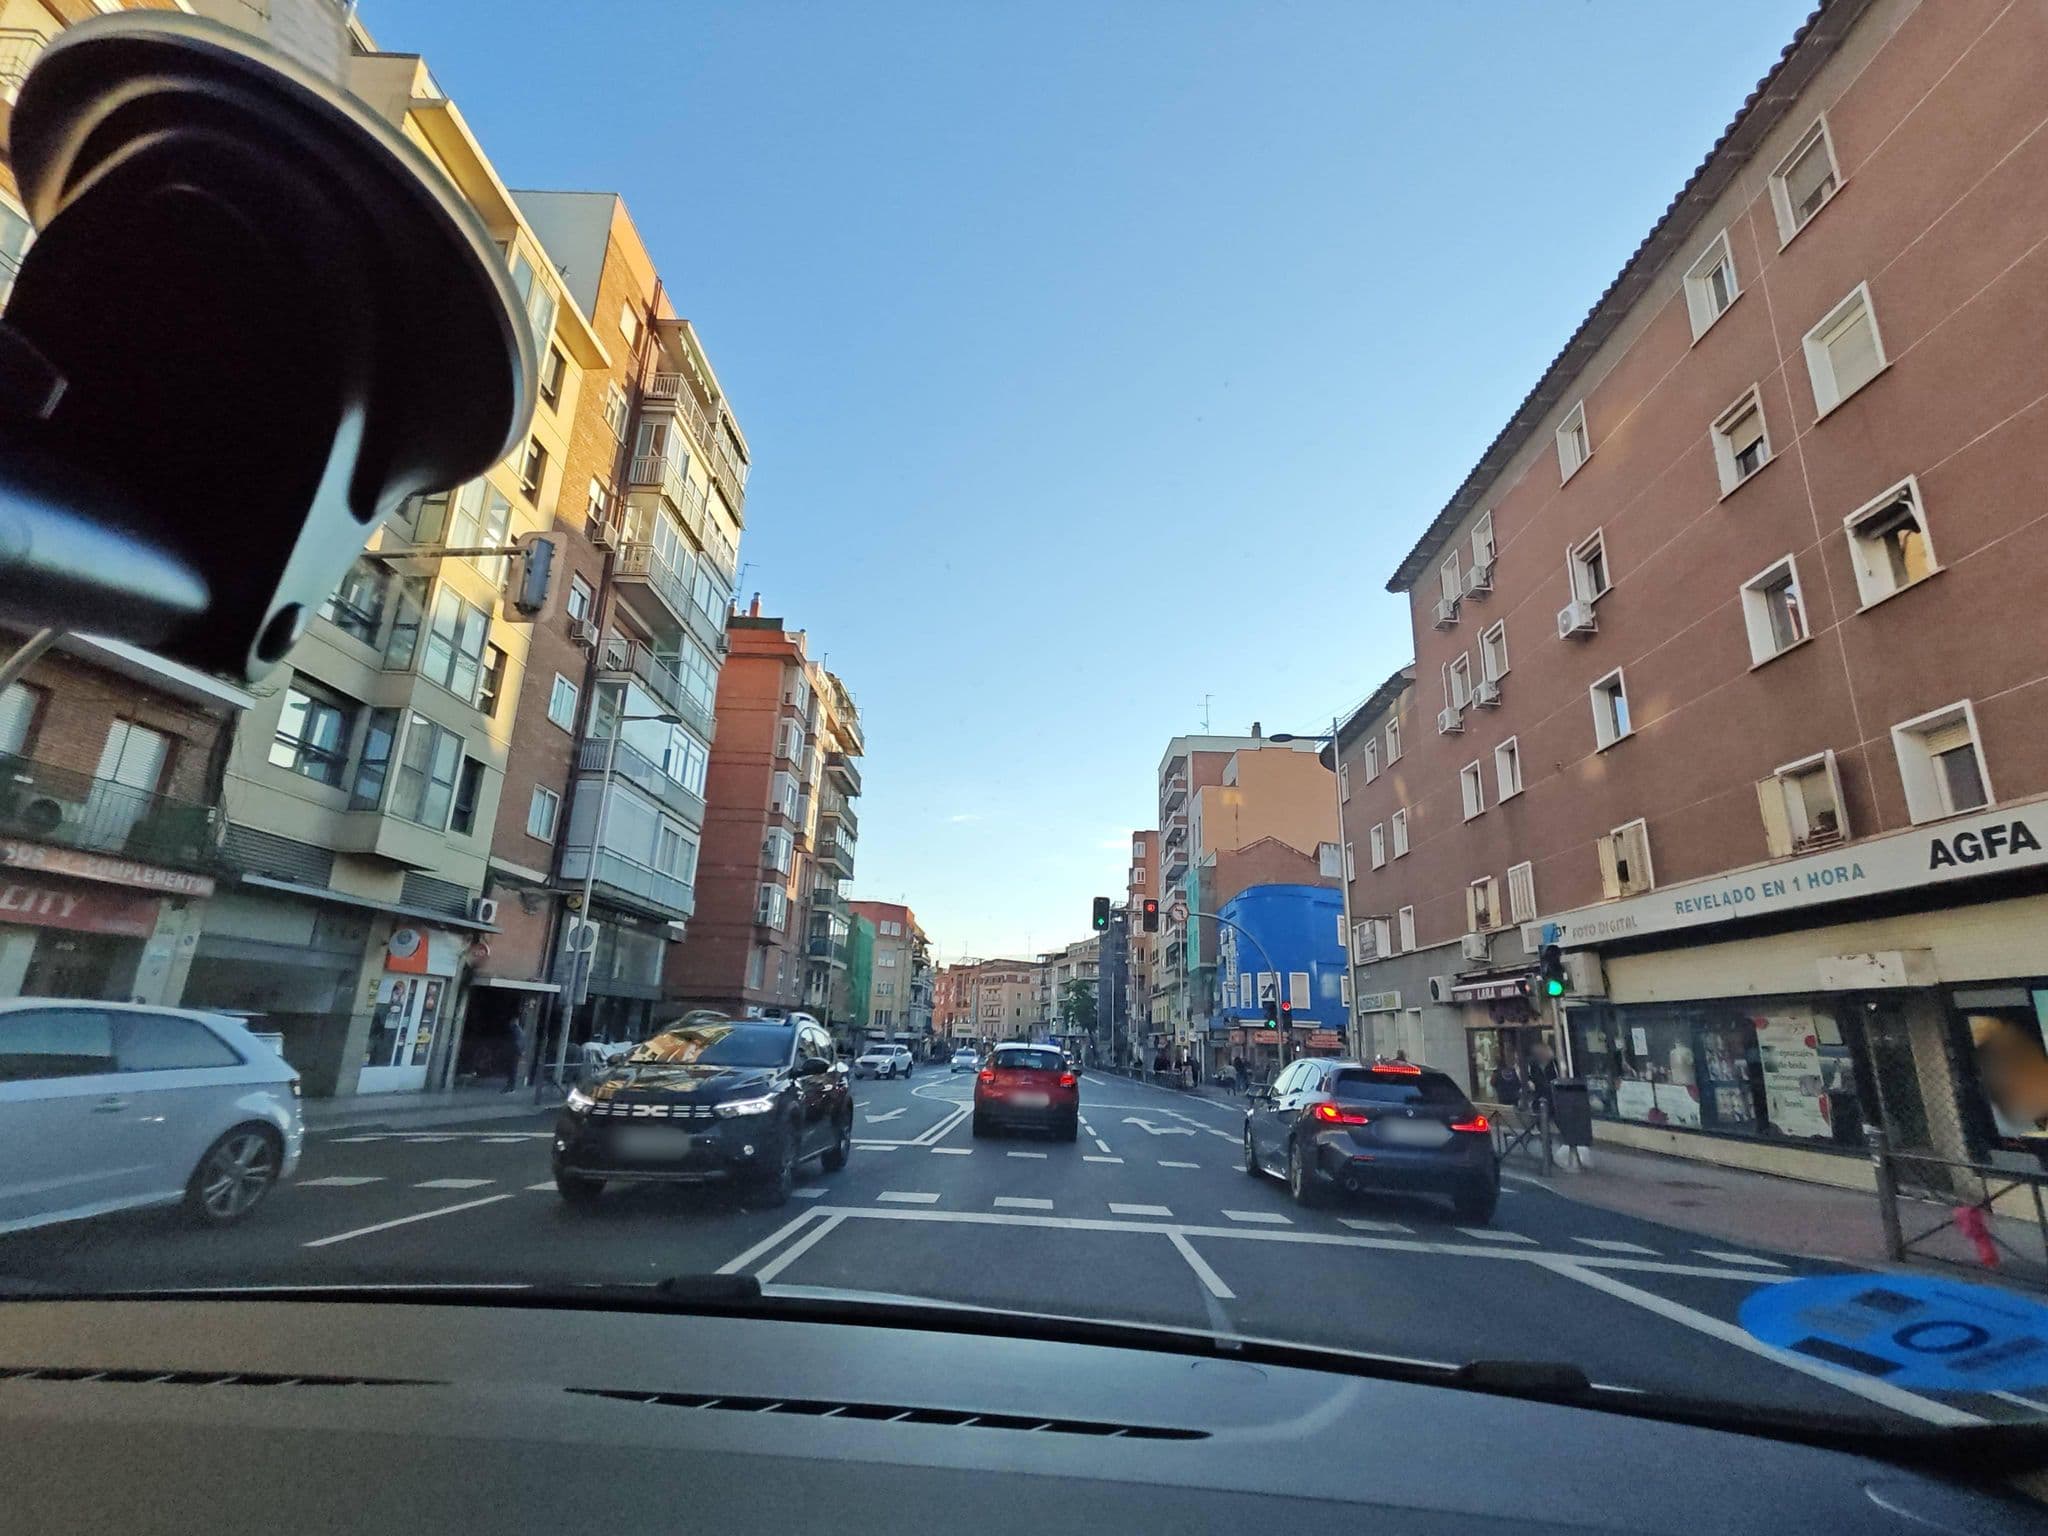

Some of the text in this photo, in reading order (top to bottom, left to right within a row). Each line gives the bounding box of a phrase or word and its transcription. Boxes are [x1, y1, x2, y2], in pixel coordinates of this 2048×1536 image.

[1929, 820, 2042, 870] AGFA
[1675, 862, 1865, 914] REVELADO EN 1 HORA
[1572, 922, 1596, 939] FOTO
[1598, 915, 1638, 935] DIGITAL
